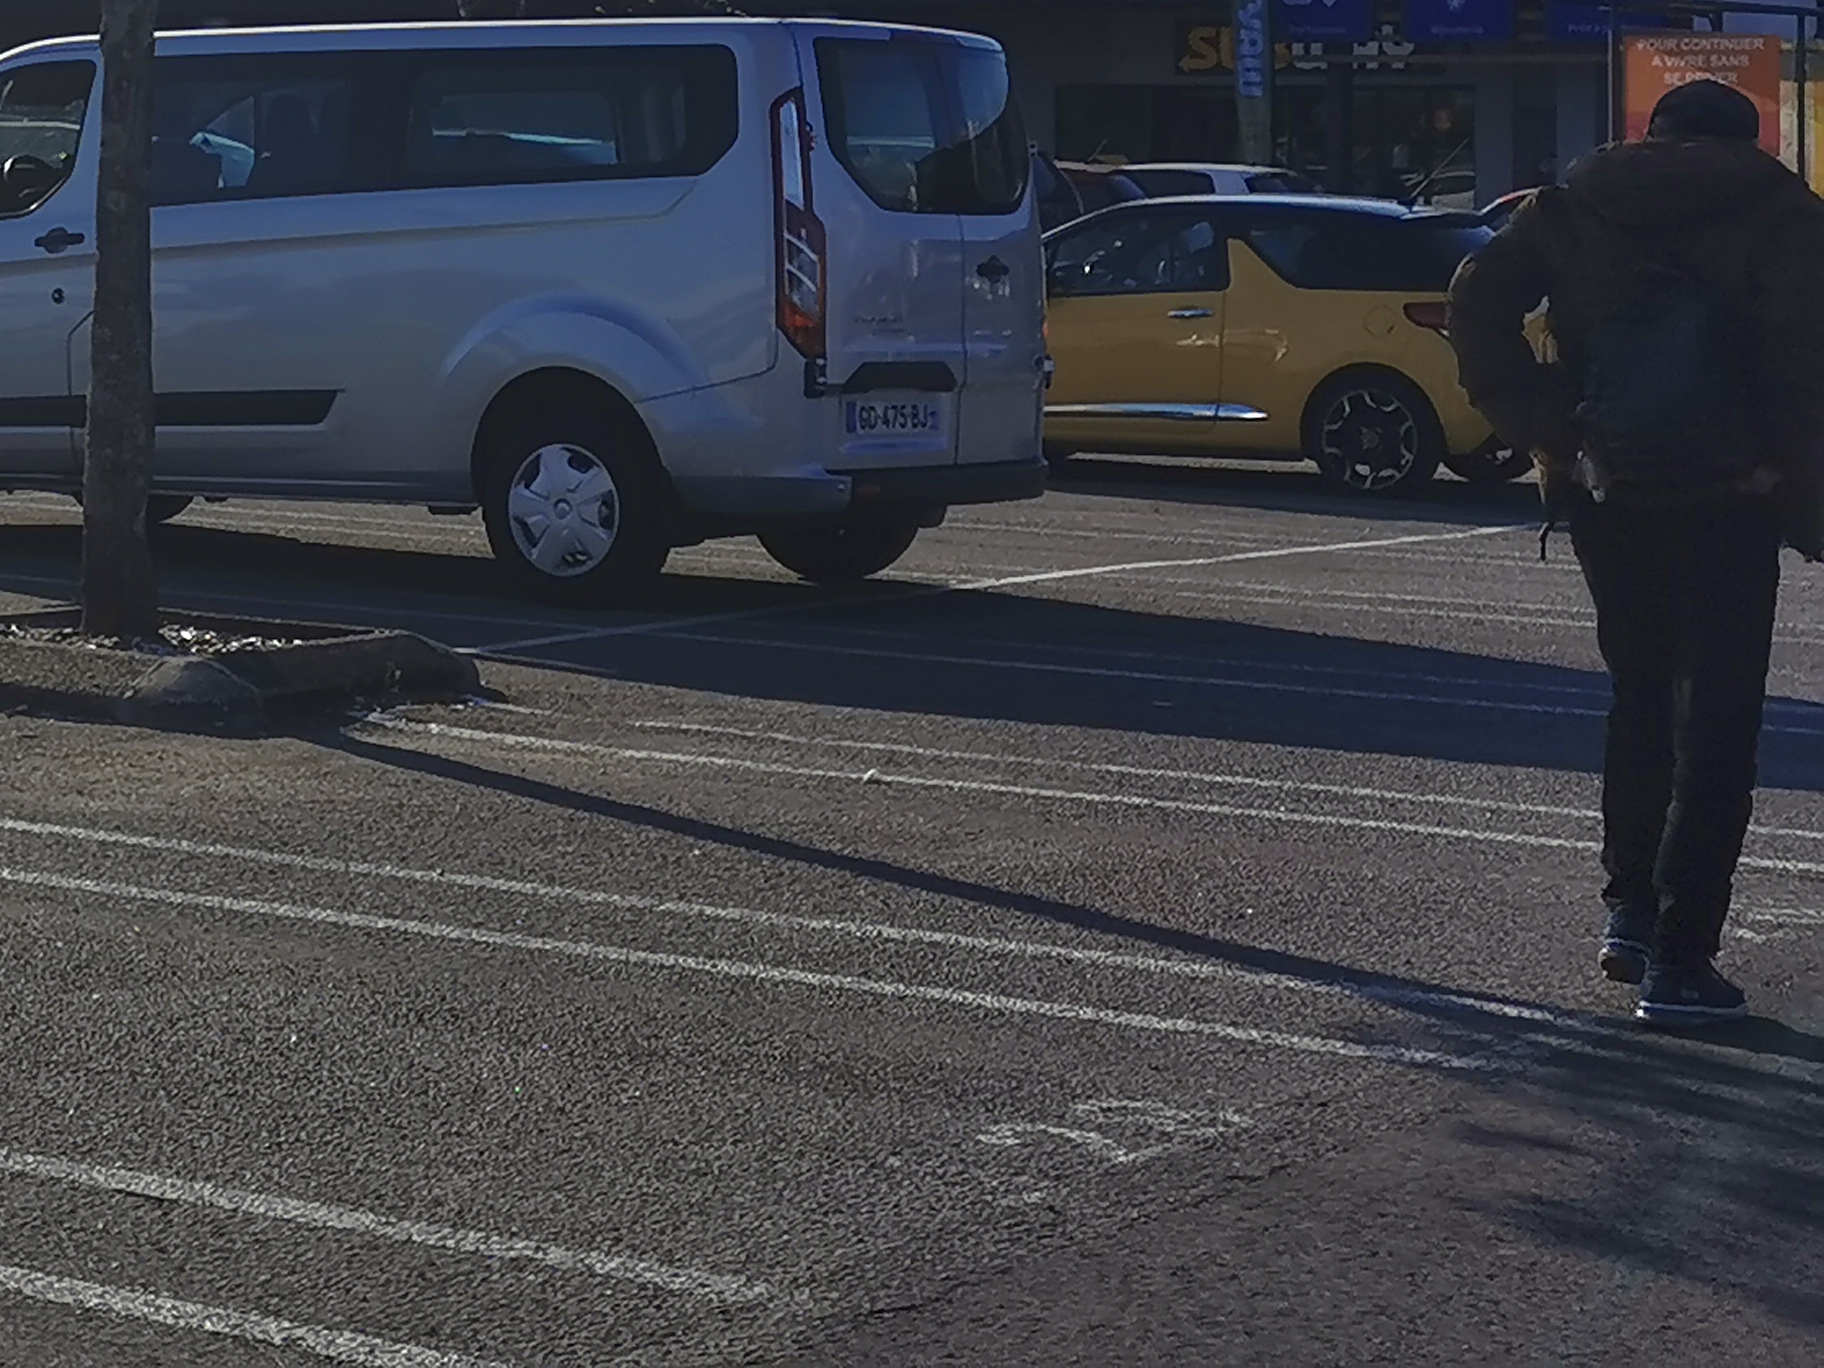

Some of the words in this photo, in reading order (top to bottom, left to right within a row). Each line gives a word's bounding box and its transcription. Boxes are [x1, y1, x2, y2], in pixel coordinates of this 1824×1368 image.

[1637, 38, 1678, 51] POUR
[1679, 37, 1765, 51] CONTINUER
[1664, 55, 1707, 67] VIVRE
[1709, 54, 1750, 67] SANS
